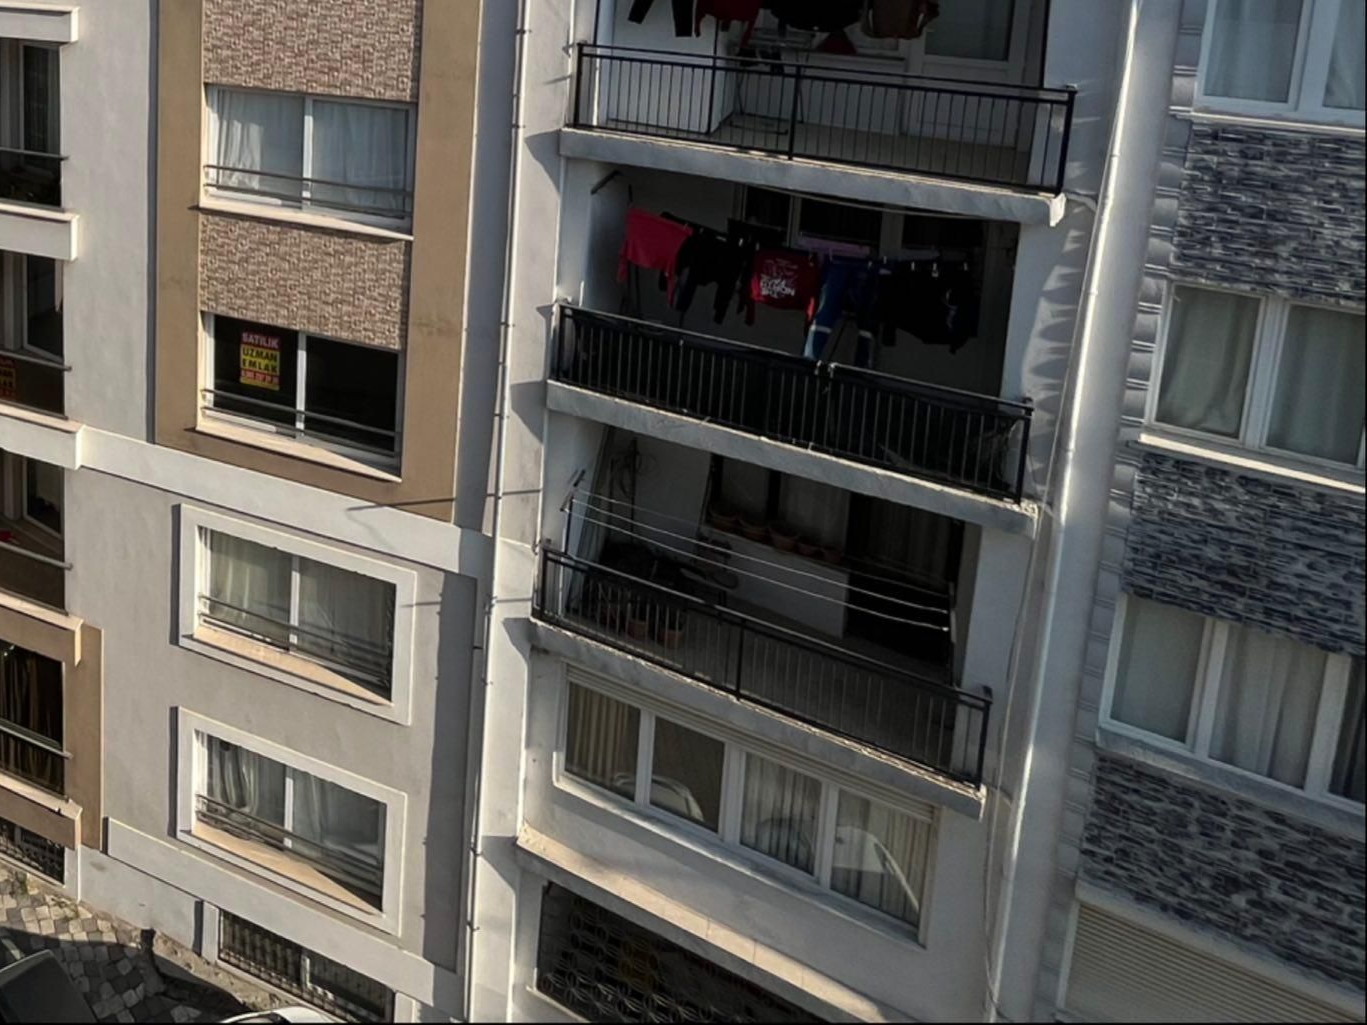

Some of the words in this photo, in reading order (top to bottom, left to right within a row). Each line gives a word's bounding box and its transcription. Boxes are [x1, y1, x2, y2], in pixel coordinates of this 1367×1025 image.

[242, 331, 279, 349] SATILIK
[242, 346, 277, 363] UZMAN
[242, 358, 277, 374] EMLAK
